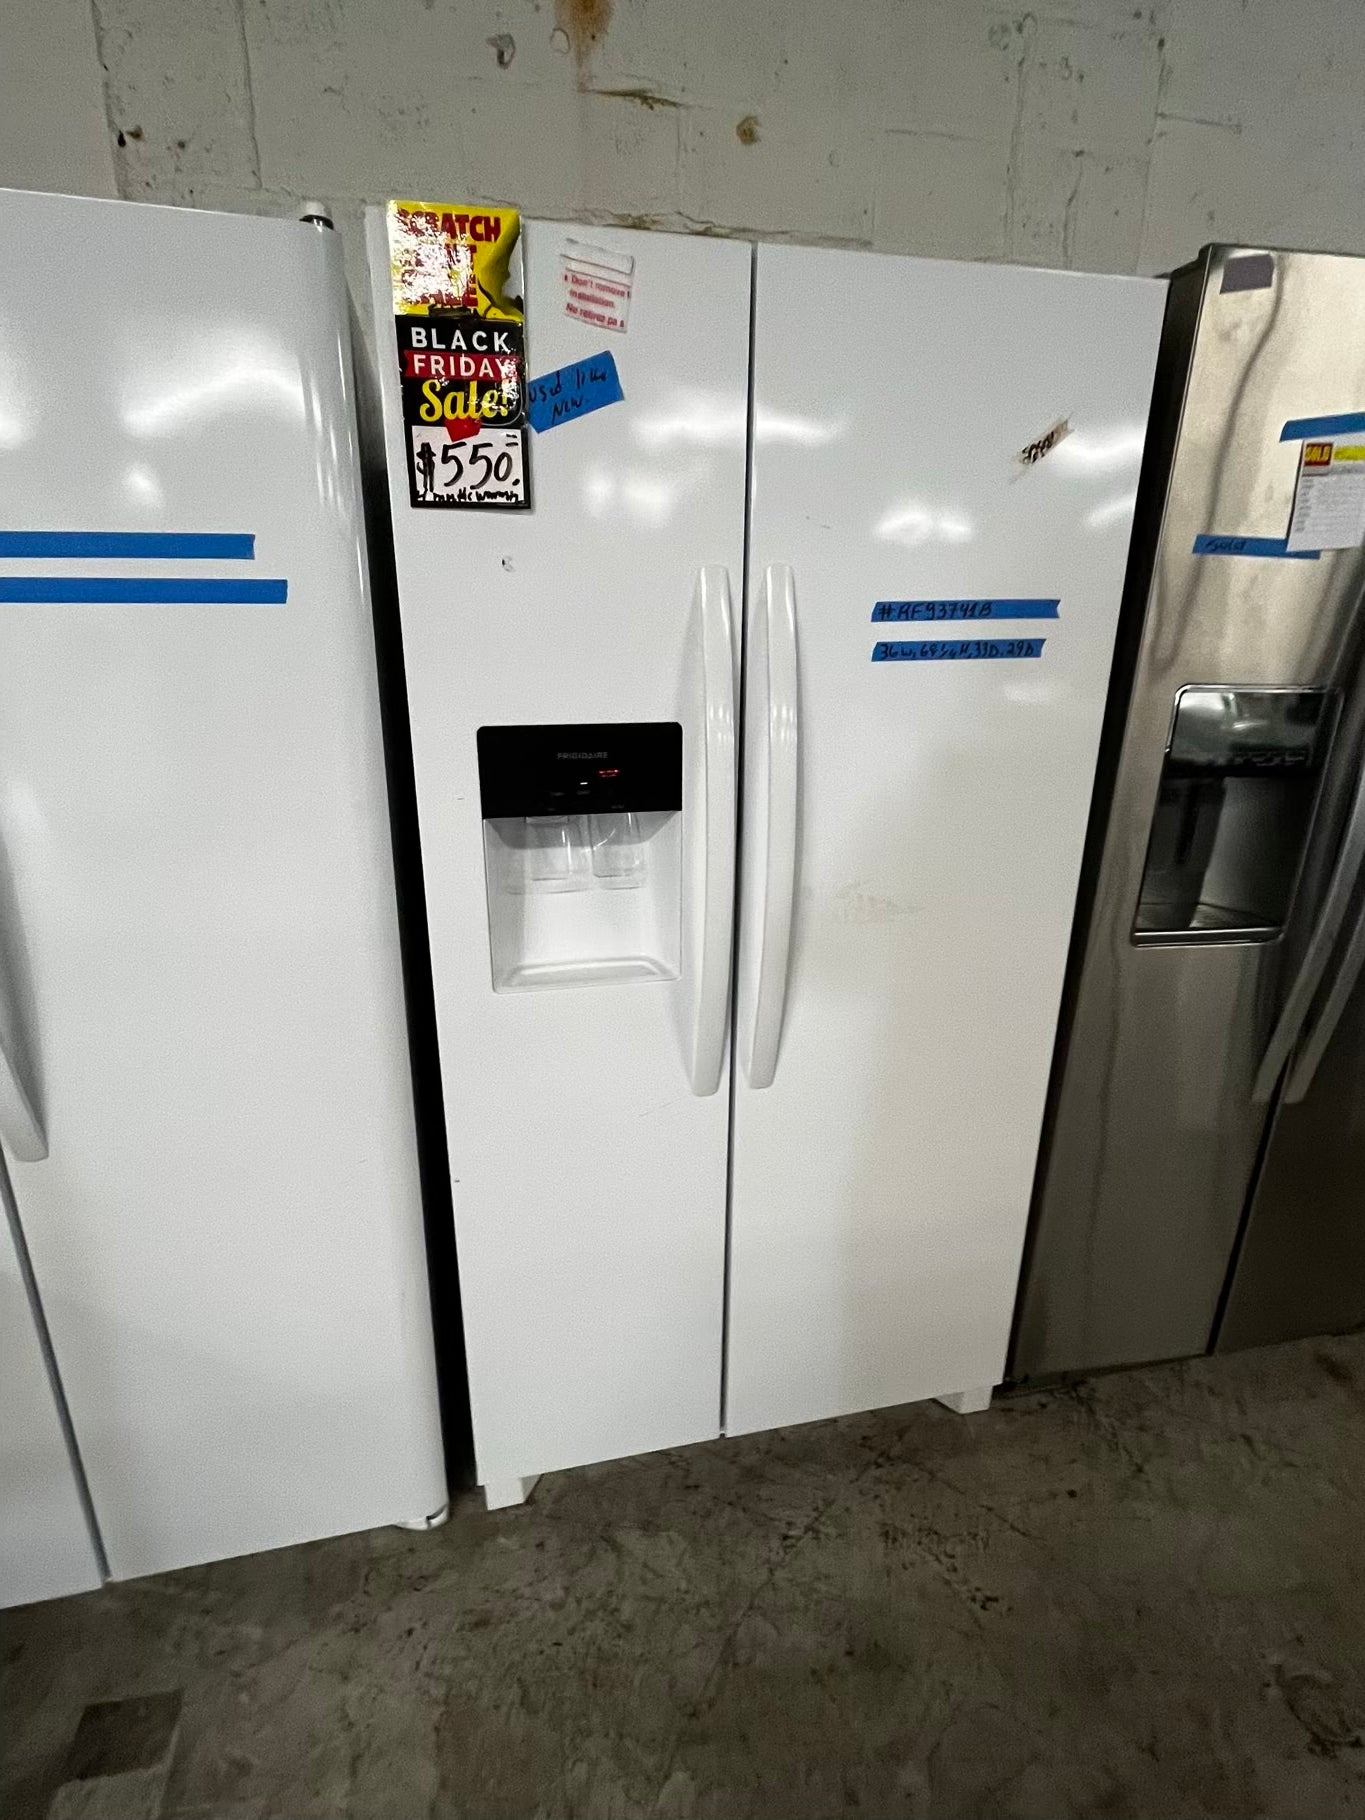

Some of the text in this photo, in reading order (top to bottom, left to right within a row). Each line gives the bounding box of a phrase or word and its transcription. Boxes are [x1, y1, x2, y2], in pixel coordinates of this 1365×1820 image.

[411, 327, 510, 353] BLACK
[413, 353, 516, 379] FRIDAY
[420, 379, 509, 422] Sale!
